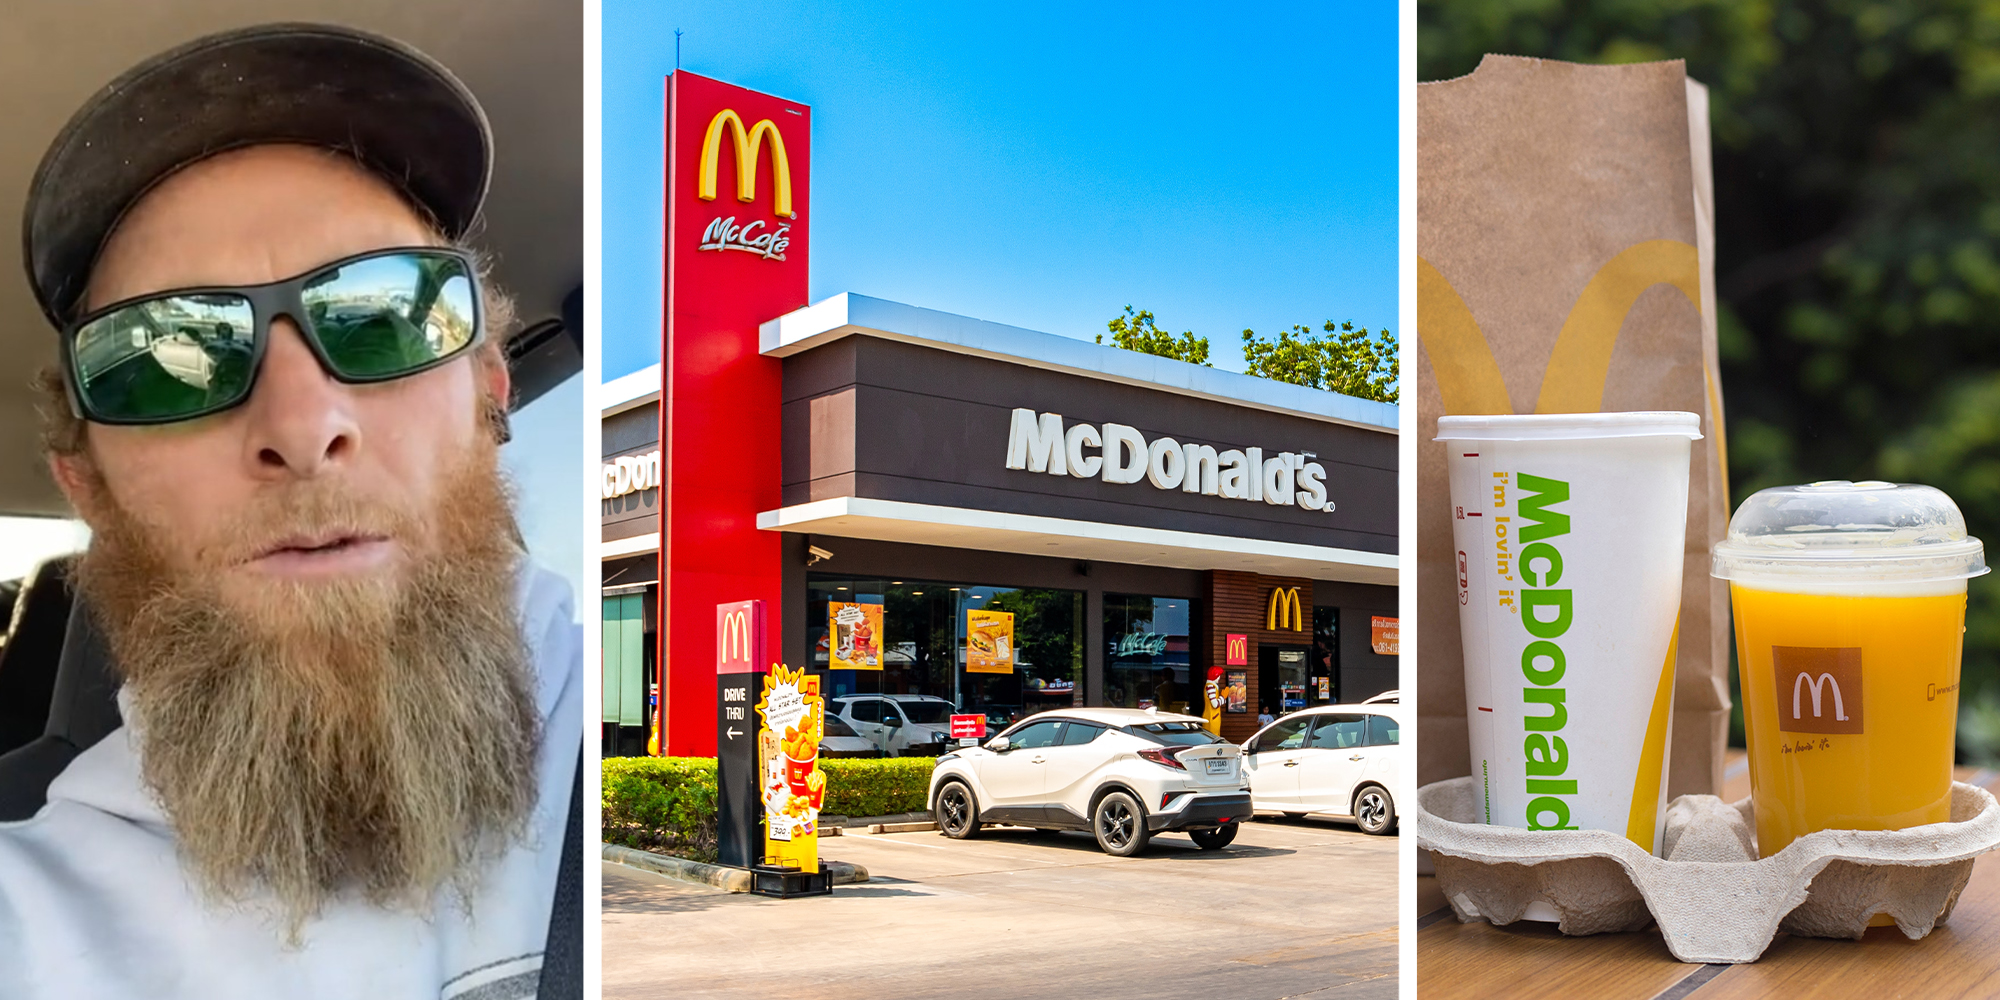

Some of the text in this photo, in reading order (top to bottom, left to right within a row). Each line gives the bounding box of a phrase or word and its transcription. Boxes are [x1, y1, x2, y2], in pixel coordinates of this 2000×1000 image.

[602, 450, 660, 500] cDon
[1005, 407, 1328, 511] McDonald's
[1493, 471, 1509, 508] i'm
[1495, 517, 1514, 581] lovin'
[724, 687, 746, 702] DRIVE
[726, 707, 744, 721] THRU
